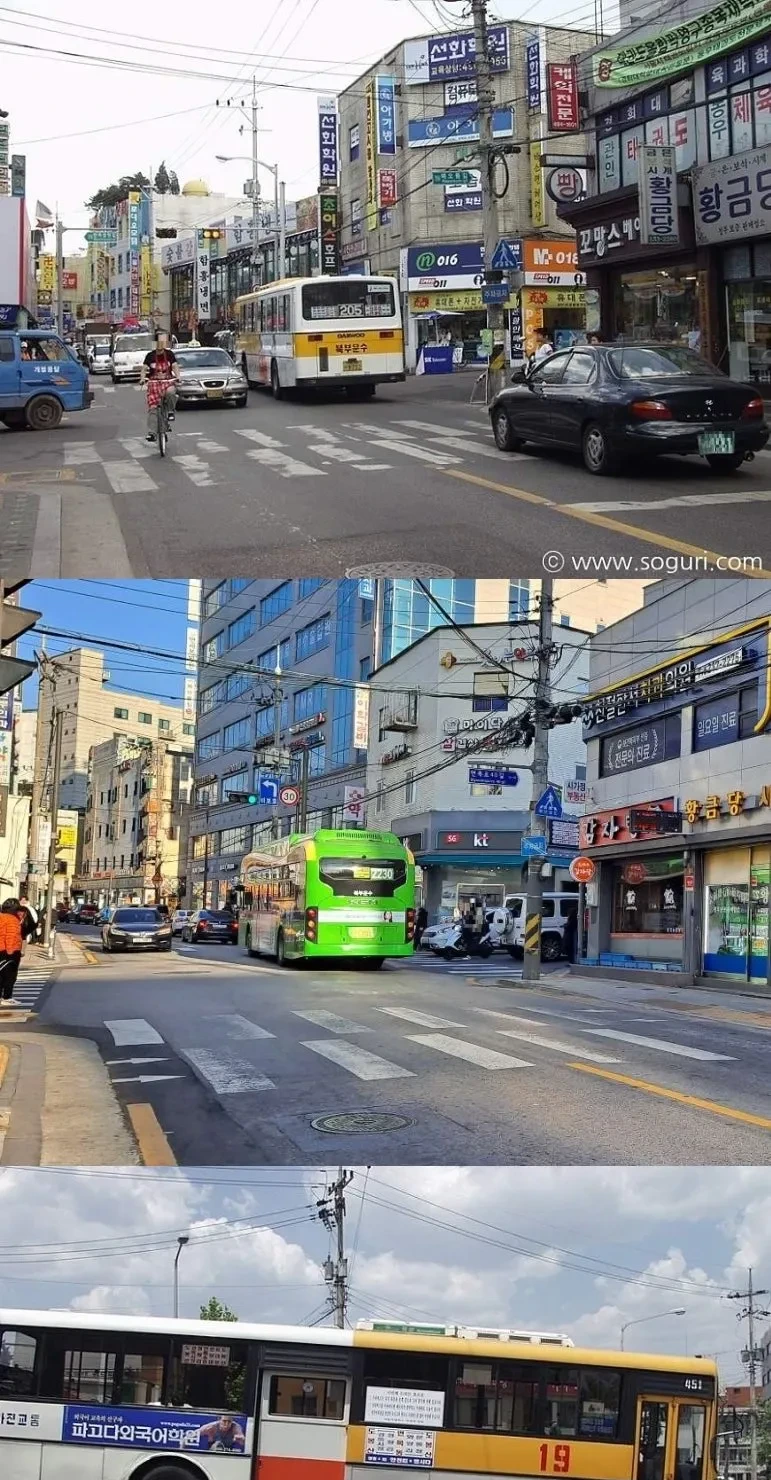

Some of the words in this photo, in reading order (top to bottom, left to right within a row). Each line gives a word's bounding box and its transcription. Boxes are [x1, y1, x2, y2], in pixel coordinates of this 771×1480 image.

[430, 33, 506, 63] 선화원
[553, 67, 574, 121] 케익전문
[380, 105, 393, 142] 아기방
[321, 116, 336, 178] 선화학원
[557, 173, 576, 196] 빵
[466, 197, 481, 205] 학원
[649, 176, 675, 234] 황금당
[437, 253, 459, 266] 016
[433, 280, 447, 288] 011
[547, 276, 560, 284] 011
[339, 305, 363, 316] 205
[336, 343, 368, 353] 북부운수
[697, 716, 719, 738] 일요일
[721, 711, 737, 729] 진료
[614, 747, 634, 769] 전문의
[636, 743, 650, 763] 진료
[284, 792, 294, 801] 30
[685, 791, 744, 824] 황금당
[473, 833, 489, 847] kt
[371, 868, 394, 879] 2230
[684, 1378, 702, 1390] 451
[72, 1422, 200, 1446] 파고다외국어학원
[539, 1443, 571, 1473] 19
